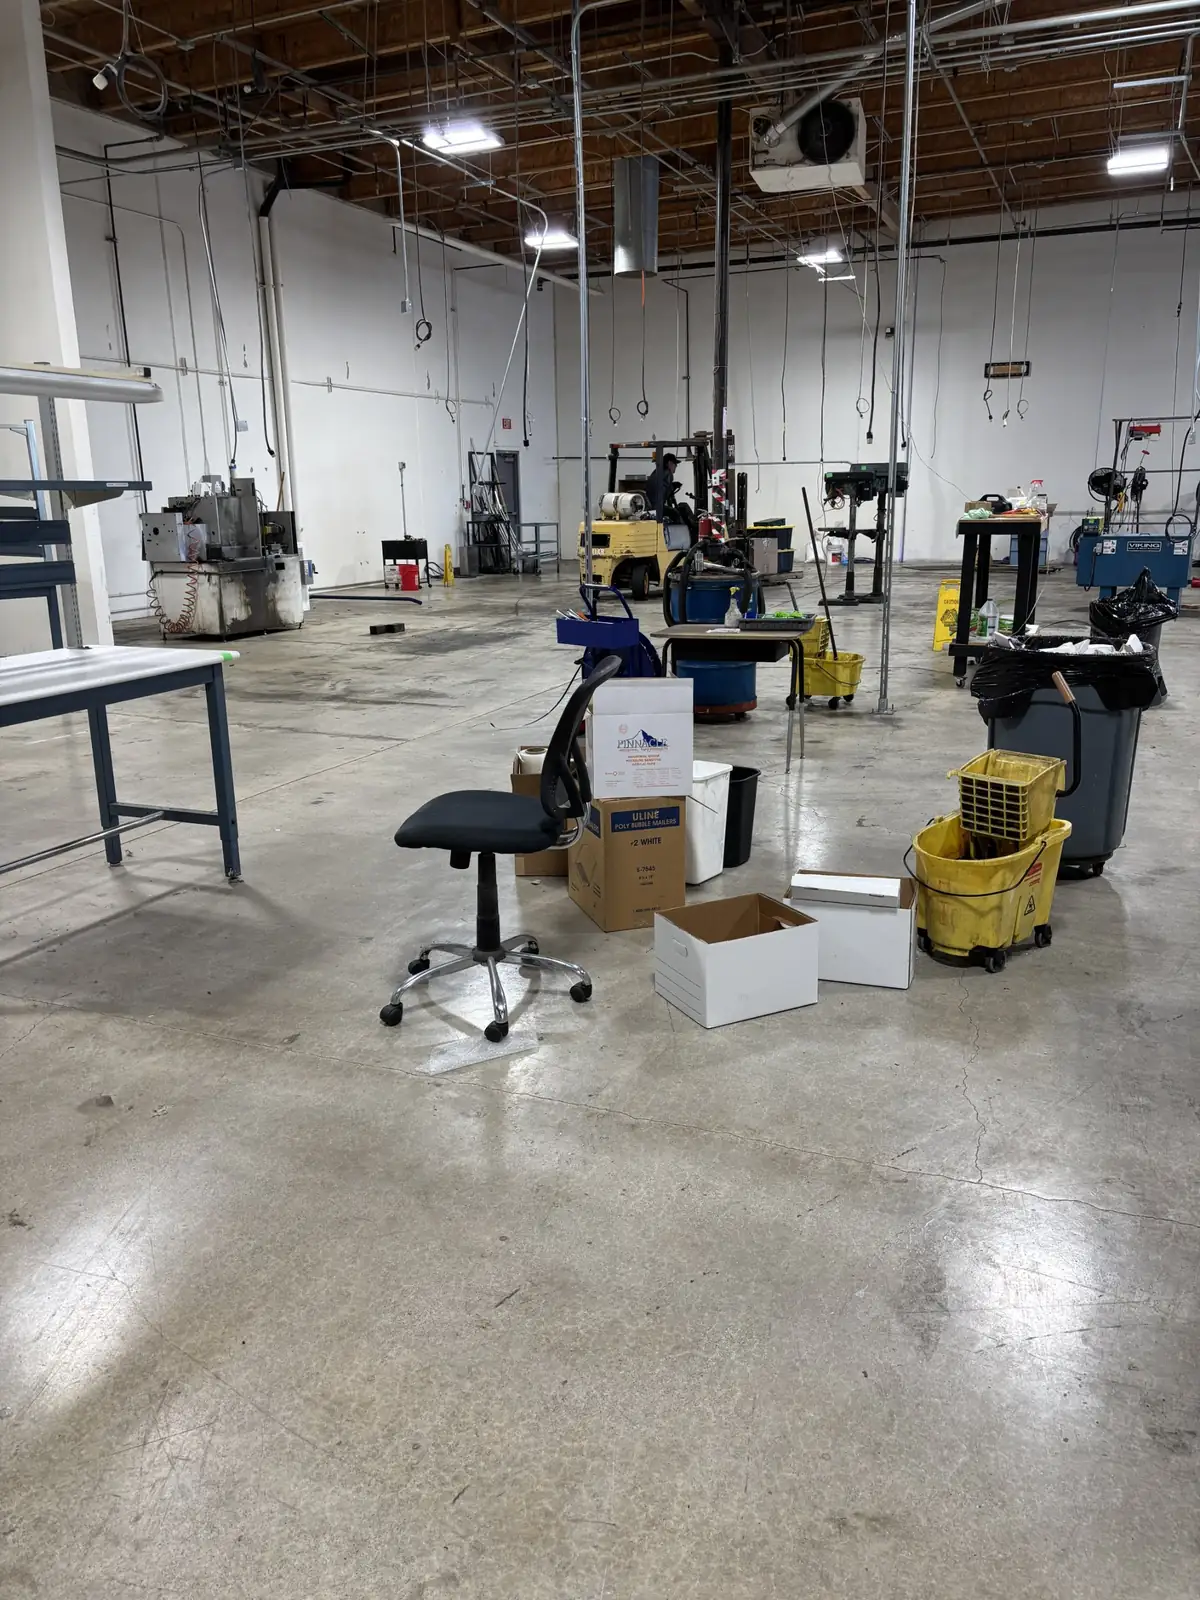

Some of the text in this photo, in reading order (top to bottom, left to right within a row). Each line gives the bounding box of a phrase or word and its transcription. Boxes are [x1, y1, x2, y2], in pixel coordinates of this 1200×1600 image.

[632, 810, 660, 821] ULINE
[631, 821, 651, 829] BUBBLE
[652, 818, 677, 827] MAILERS
[640, 837, 662, 846] WHITE
